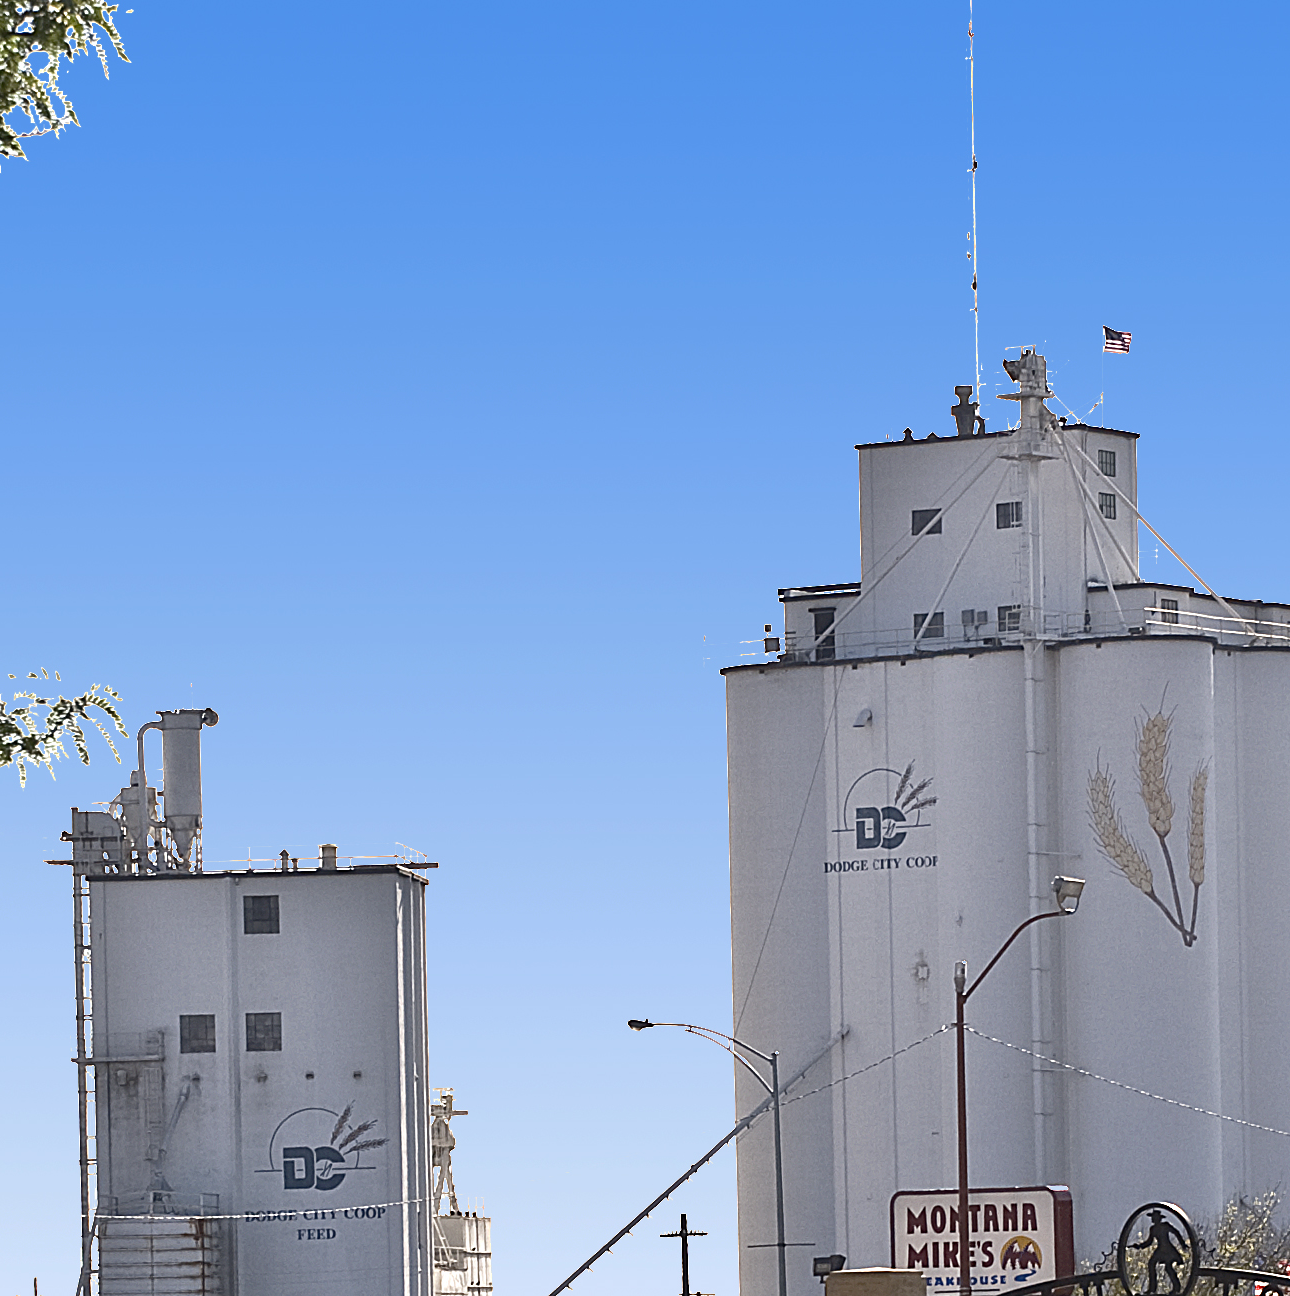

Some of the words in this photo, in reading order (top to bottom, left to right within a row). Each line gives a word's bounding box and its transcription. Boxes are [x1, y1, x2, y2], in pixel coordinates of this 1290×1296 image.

[823, 859, 868, 874] DODGE
[872, 857, 902, 871] CITY
[245, 1209, 298, 1223] DODGE
[303, 1208, 338, 1221] CITY
[343, 1206, 387, 1220] COOP
[906, 1202, 1038, 1235] MONTANA
[296, 1228, 337, 1241] FEED
[907, 1240, 995, 1269] MIKE'S
[926, 1274, 1007, 1286] EAKOUSE
